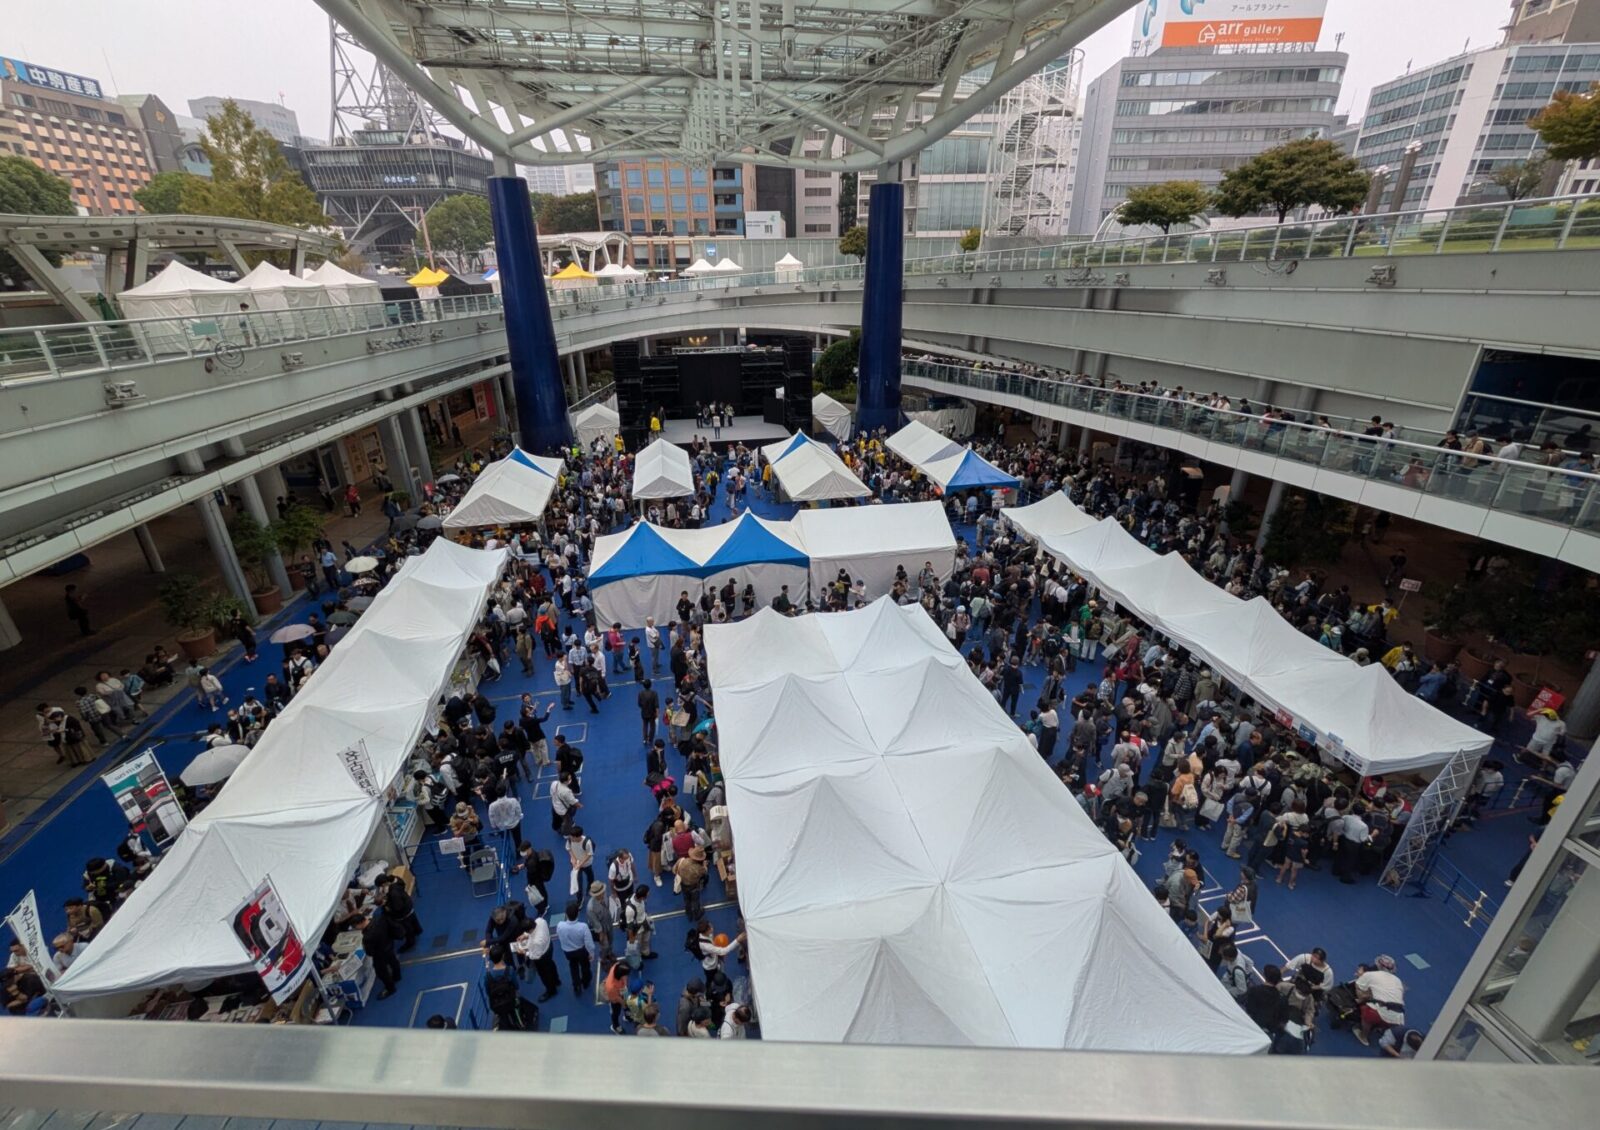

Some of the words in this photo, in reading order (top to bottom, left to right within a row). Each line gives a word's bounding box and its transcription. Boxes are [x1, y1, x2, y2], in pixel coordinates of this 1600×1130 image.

[1231, 3, 1289, 12] アールプランナー
[1217, 22, 1244, 35] arr
[1243, 24, 1285, 37] gallery
[28, 67, 100, 97] 中駒産業
